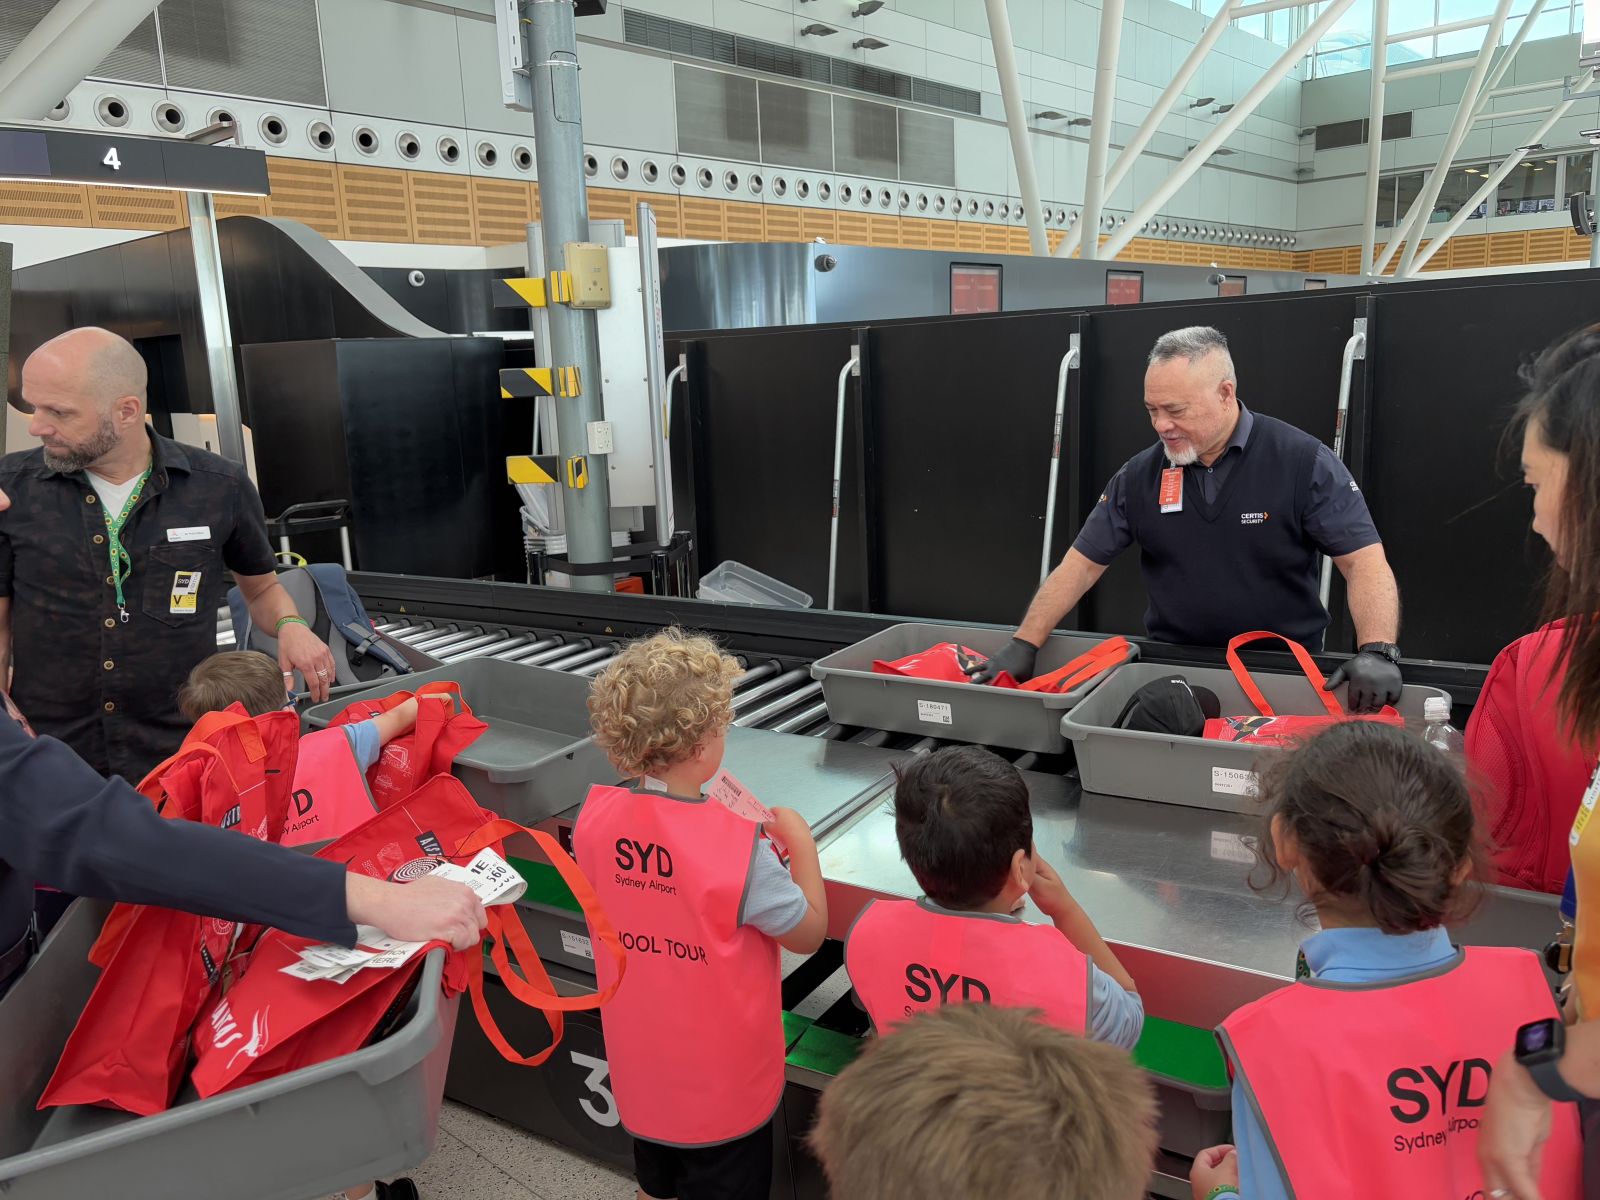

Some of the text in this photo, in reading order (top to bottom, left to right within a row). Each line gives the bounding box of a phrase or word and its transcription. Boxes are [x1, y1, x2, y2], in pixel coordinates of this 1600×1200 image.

[103, 147, 121, 170] 4
[291, 814, 320, 833] Airport
[615, 837, 673, 878] SYD
[615, 874, 677, 896] Sydney Airport
[664, 938, 708, 966] TOUR
[904, 963, 991, 1005] SYD
[570, 1050, 620, 1127] 3
[1386, 1057, 1492, 1124] SYD
[1393, 1131, 1448, 1155] Sydney
